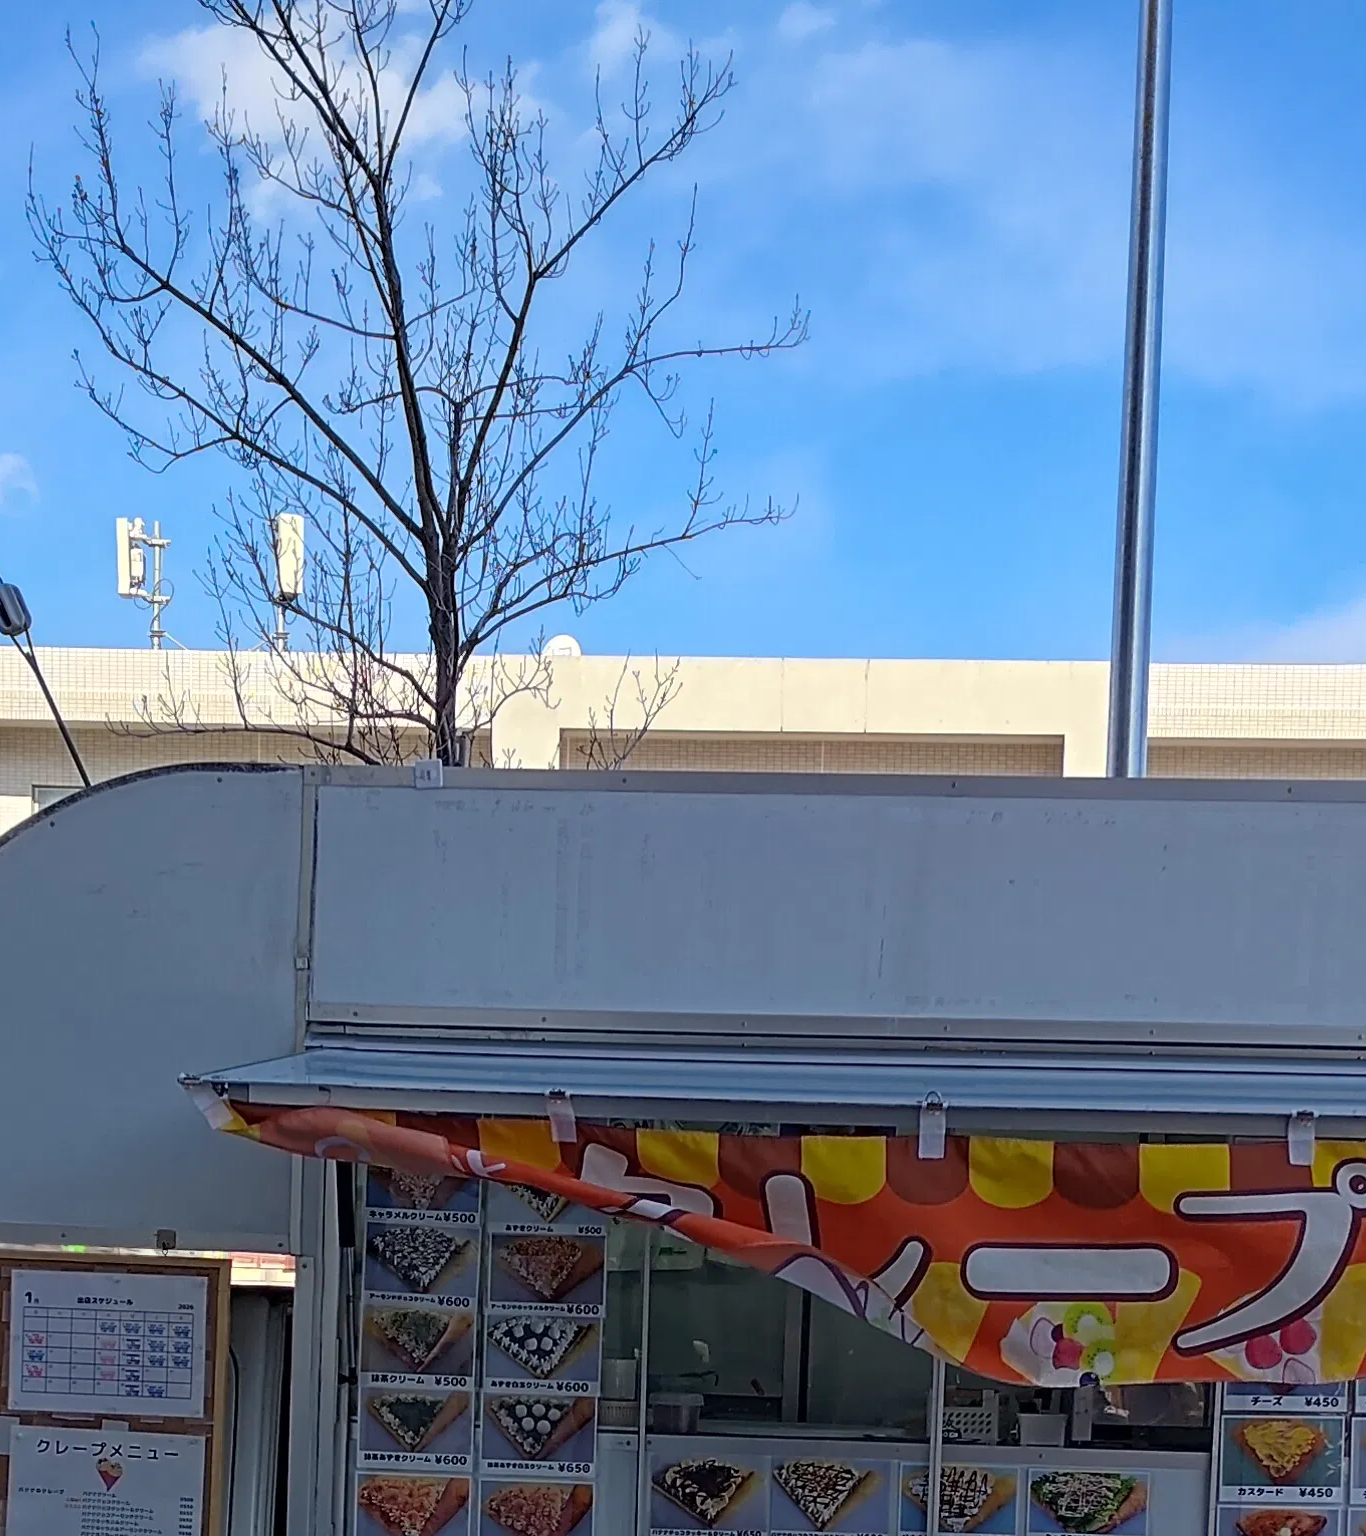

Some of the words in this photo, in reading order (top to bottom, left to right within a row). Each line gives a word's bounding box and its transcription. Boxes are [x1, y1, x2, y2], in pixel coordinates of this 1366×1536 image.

[443, 1212, 476, 1224] ¥500
[438, 1296, 470, 1308] ¥600
[567, 1304, 600, 1315] ¥600
[435, 1376, 467, 1388] ¥500
[556, 1381, 589, 1393] ¥600
[1251, 1396, 1283, 1407] チーズ
[1304, 1397, 1339, 1408] ¥450
[37, 1439, 180, 1461] クレープメニュー
[435, 1455, 468, 1466] ¥600
[558, 1463, 591, 1474] ¥650
[1237, 1488, 1284, 1498] カスタード
[1298, 1488, 1333, 1499] ¥450
